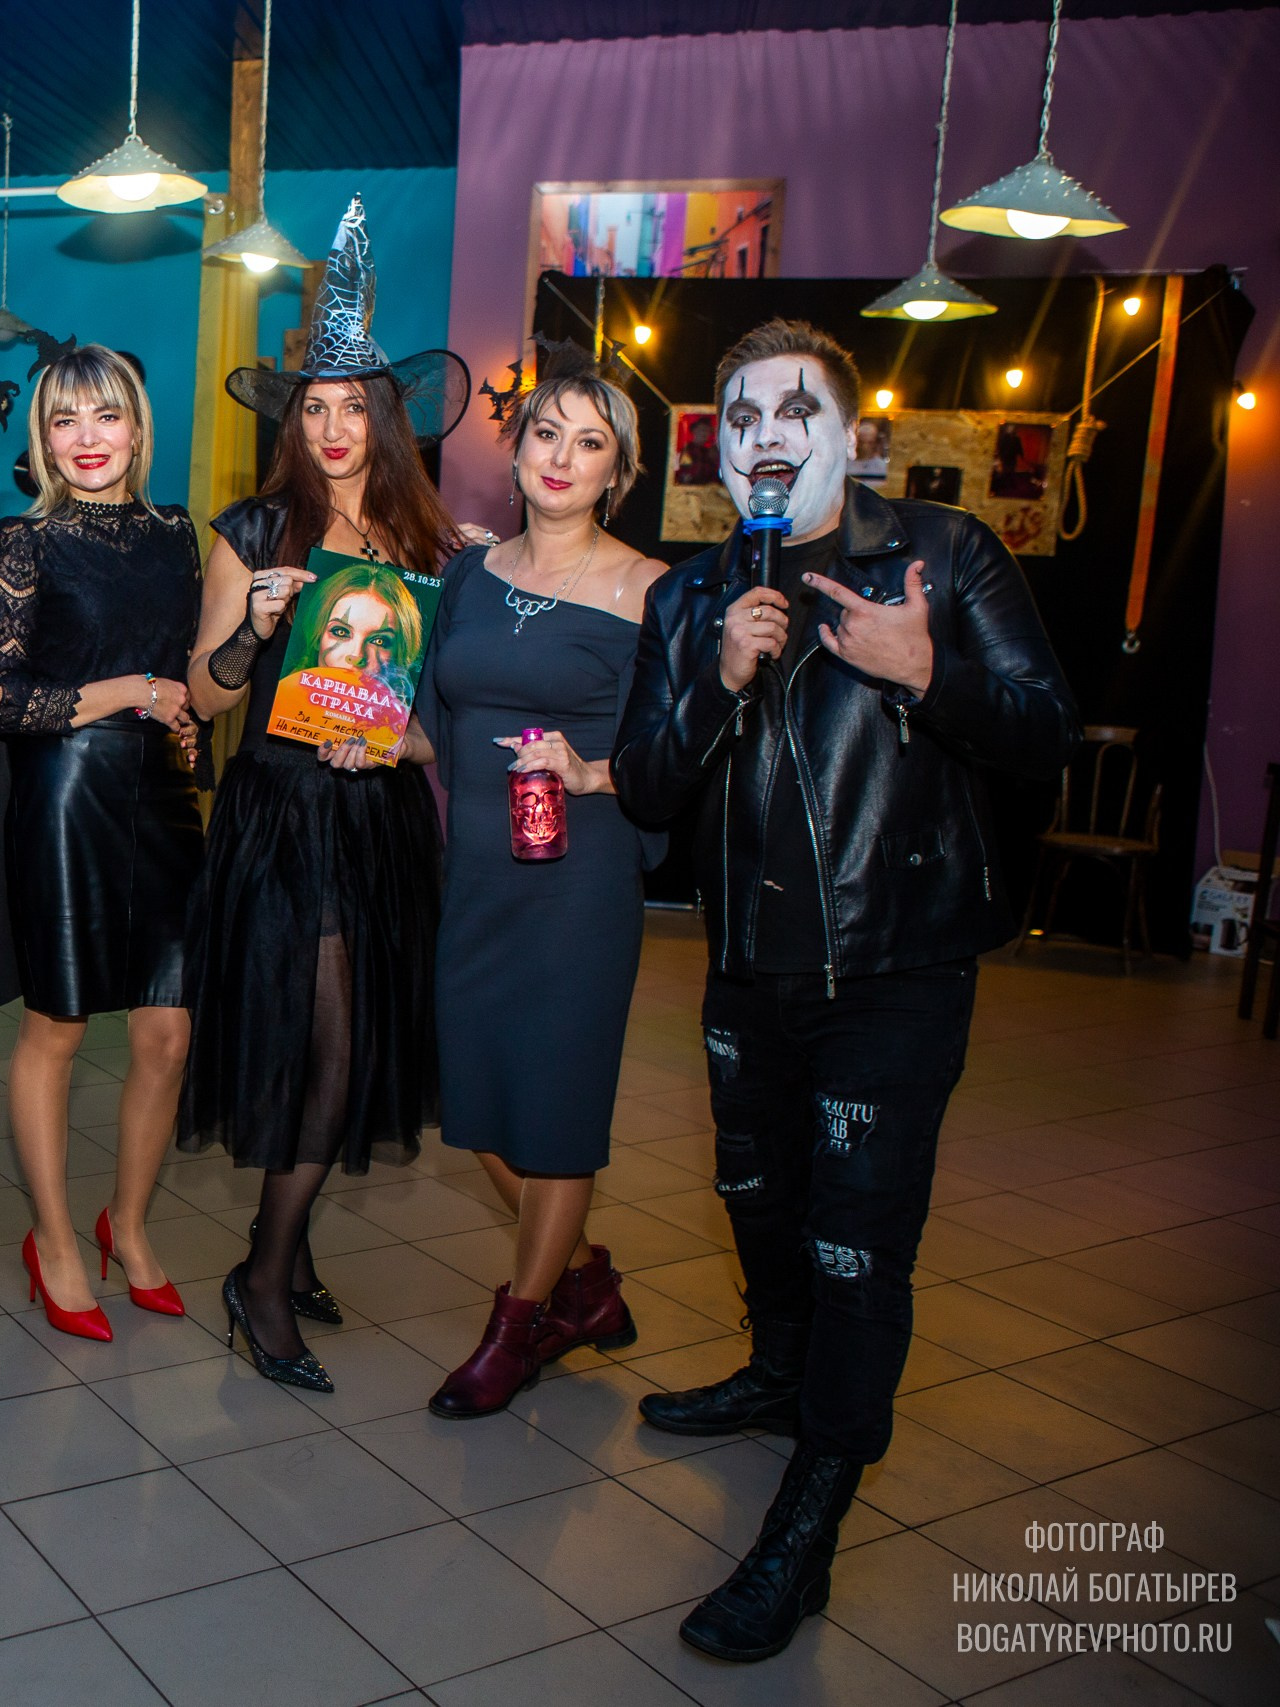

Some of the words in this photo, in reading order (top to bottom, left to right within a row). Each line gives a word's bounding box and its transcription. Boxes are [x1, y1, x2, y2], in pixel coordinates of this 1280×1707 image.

[403, 571, 441, 588] 28.10.23
[300, 672, 391, 707] КАРНАВАЛ
[310, 692, 374, 720] СТРАХА
[324, 710, 356, 723] КОМАНДА
[290, 726, 320, 740] МЕТЛЕ
[333, 725, 364, 737] МЕСТО
[823, 1099, 873, 1123] EAUTU
